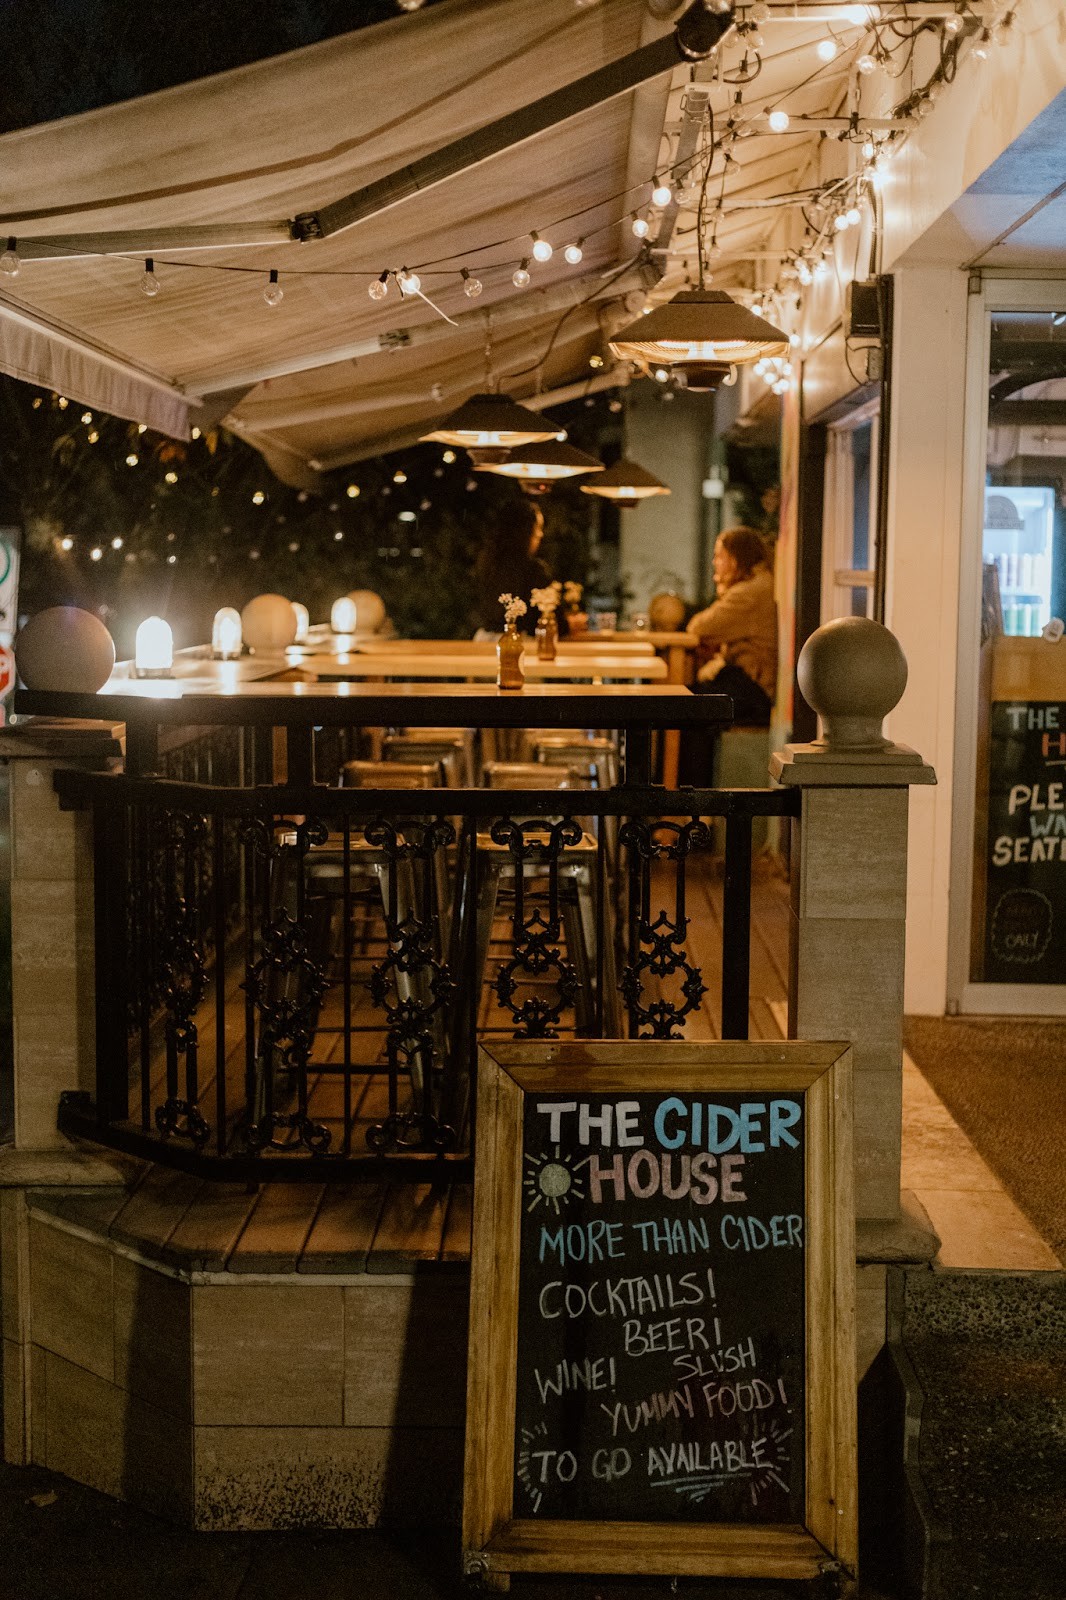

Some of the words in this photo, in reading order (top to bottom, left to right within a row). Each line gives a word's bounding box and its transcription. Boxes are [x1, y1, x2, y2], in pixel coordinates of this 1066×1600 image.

[1006, 706, 1060, 731] THE
[536, 1101, 645, 1148] THE
[654, 1096, 802, 1155] CIDER
[589, 1149, 748, 1205] HOUSE
[538, 1219, 626, 1267] MORE
[632, 1217, 710, 1255] THAN
[720, 1214, 804, 1253] CIDER
[538, 1267, 718, 1319] COCKTAILS!
[623, 1317, 722, 1357] BEER!
[672, 1336, 757, 1381] SLUSH
[534, 1356, 617, 1404] WINE!
[600, 1385, 695, 1437] YUMMY
[702, 1378, 793, 1418] FOOD!
[531, 1450, 578, 1483] TO
[591, 1448, 632, 1482] GO
[647, 1437, 774, 1477] AVAILABLE
